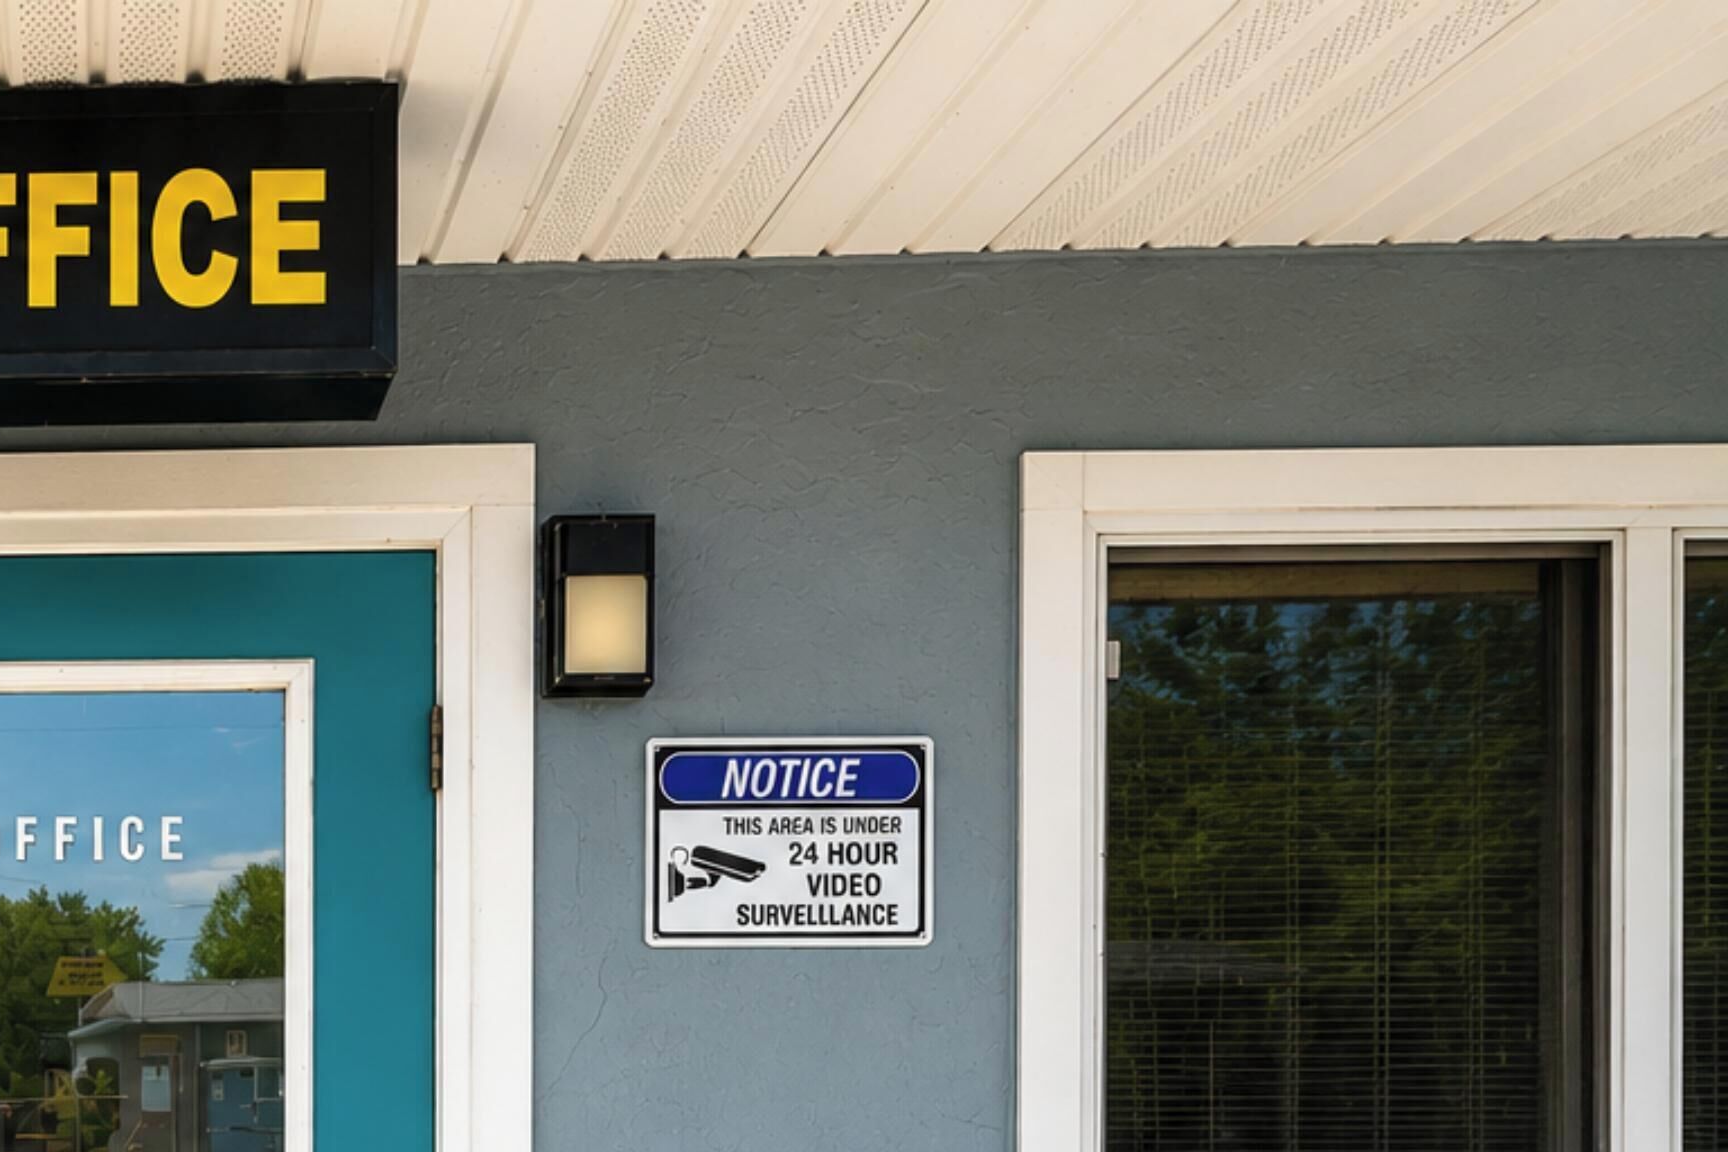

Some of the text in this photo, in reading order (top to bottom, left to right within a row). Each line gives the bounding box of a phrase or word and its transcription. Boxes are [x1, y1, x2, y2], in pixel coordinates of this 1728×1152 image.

[721, 758, 861, 799] NOTICE
[722, 816, 902, 835] THIS AREA IS UNDER
[789, 841, 899, 865] 24 HOUR
[807, 873, 882, 897] VIDEO
